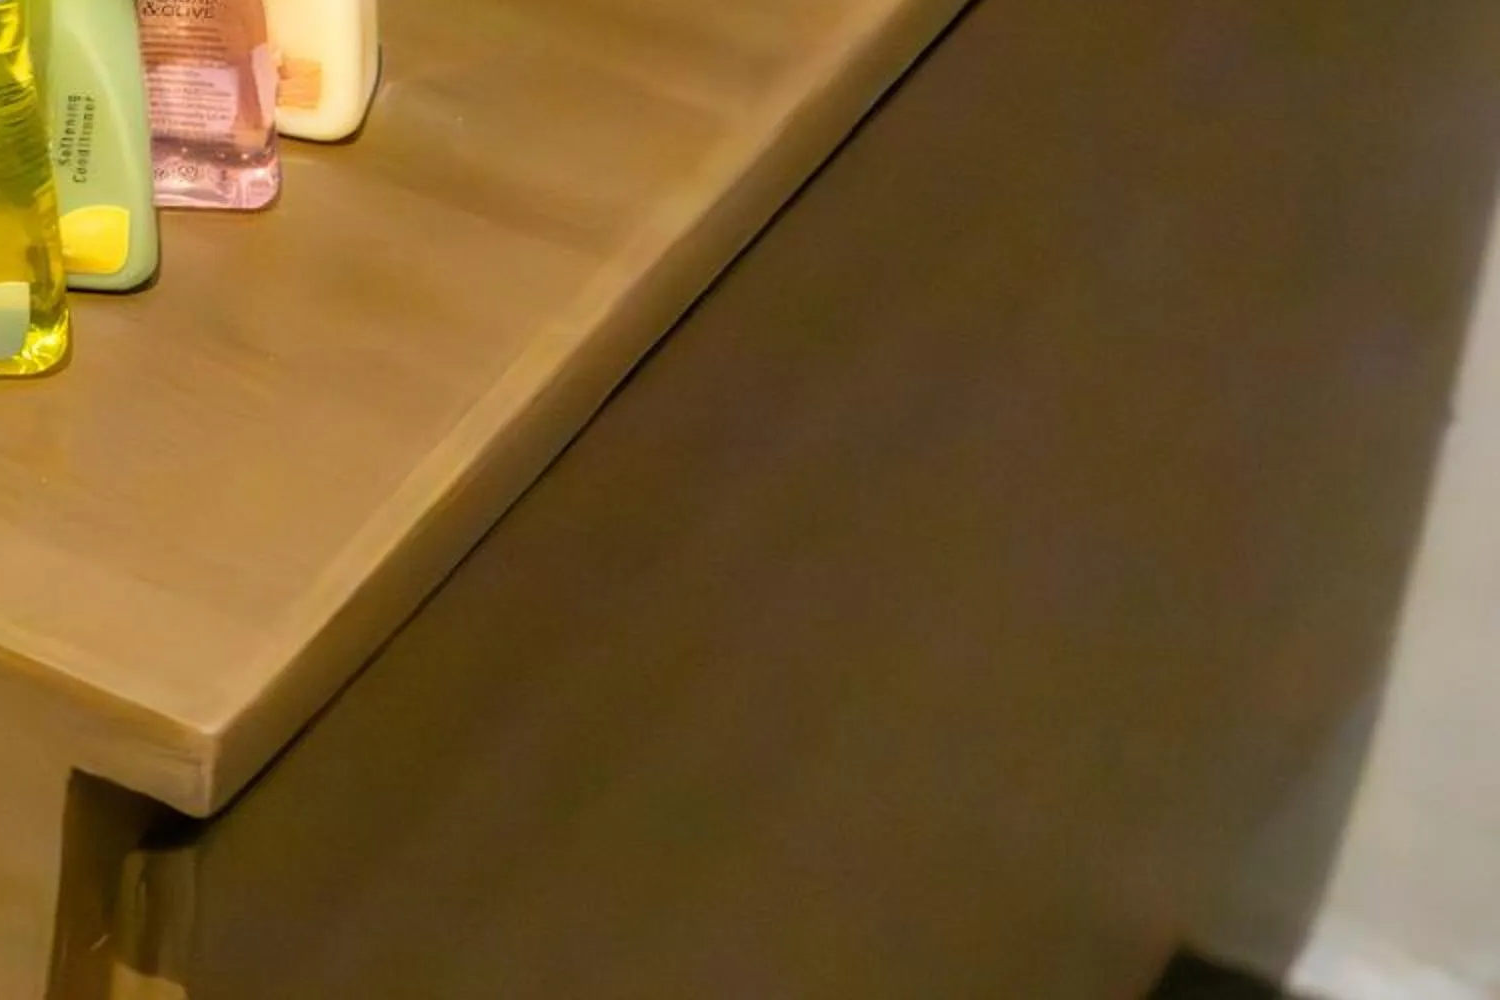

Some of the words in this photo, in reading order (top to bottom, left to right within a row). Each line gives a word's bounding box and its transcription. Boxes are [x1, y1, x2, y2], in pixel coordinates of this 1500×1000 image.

[142, 2, 215, 19] &OLIVE
[58, 95, 81, 167] Softening
[72, 96, 95, 183] Conditioner
